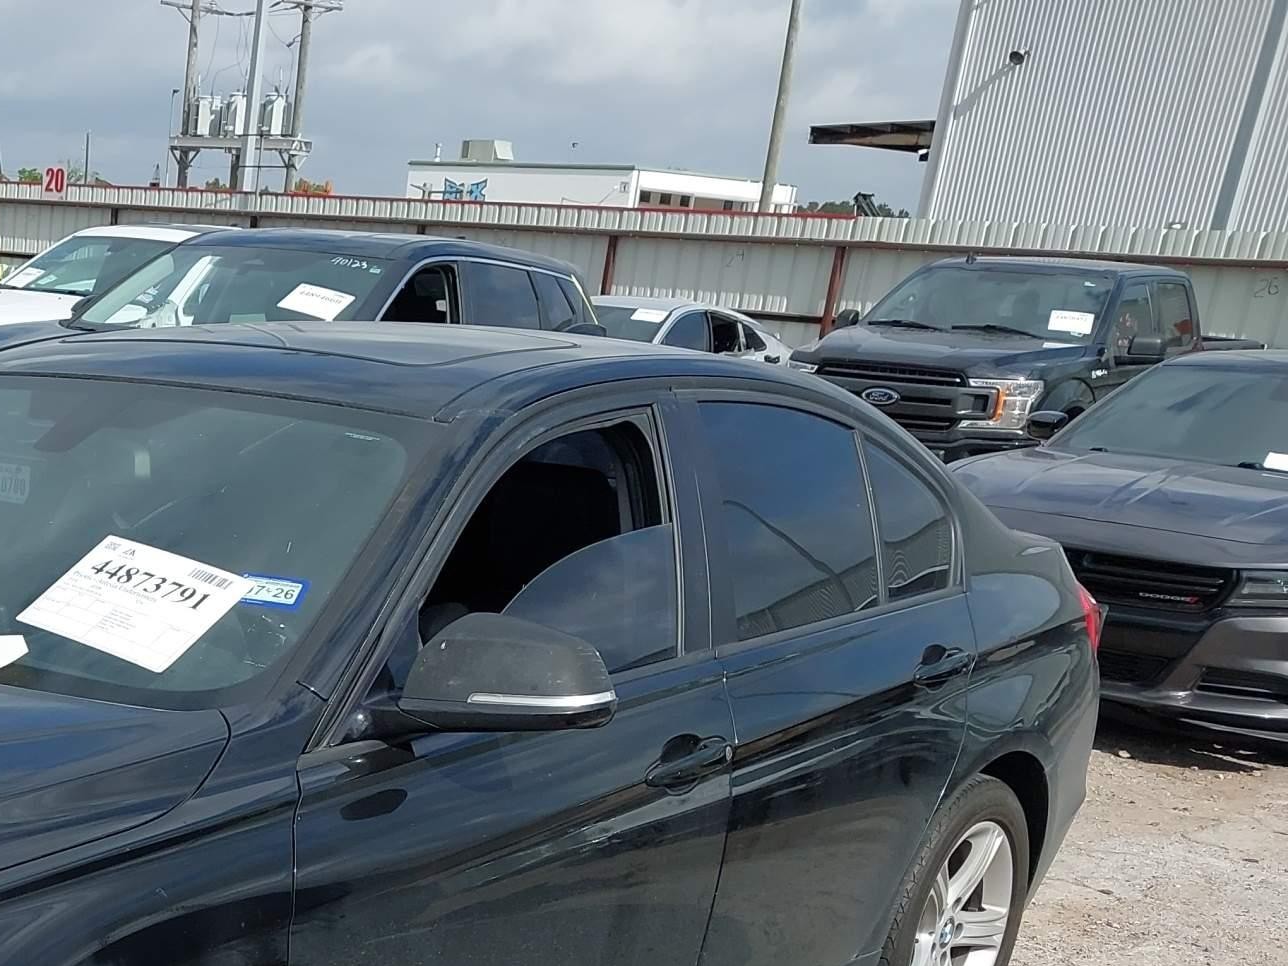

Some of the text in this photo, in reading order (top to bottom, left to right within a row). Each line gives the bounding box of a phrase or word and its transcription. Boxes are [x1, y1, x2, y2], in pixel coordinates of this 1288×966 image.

[44, 167, 65, 193] 20
[1253, 278, 1280, 298] 26
[90, 559, 211, 610] 44873791
[272, 587, 296, 600] 26
